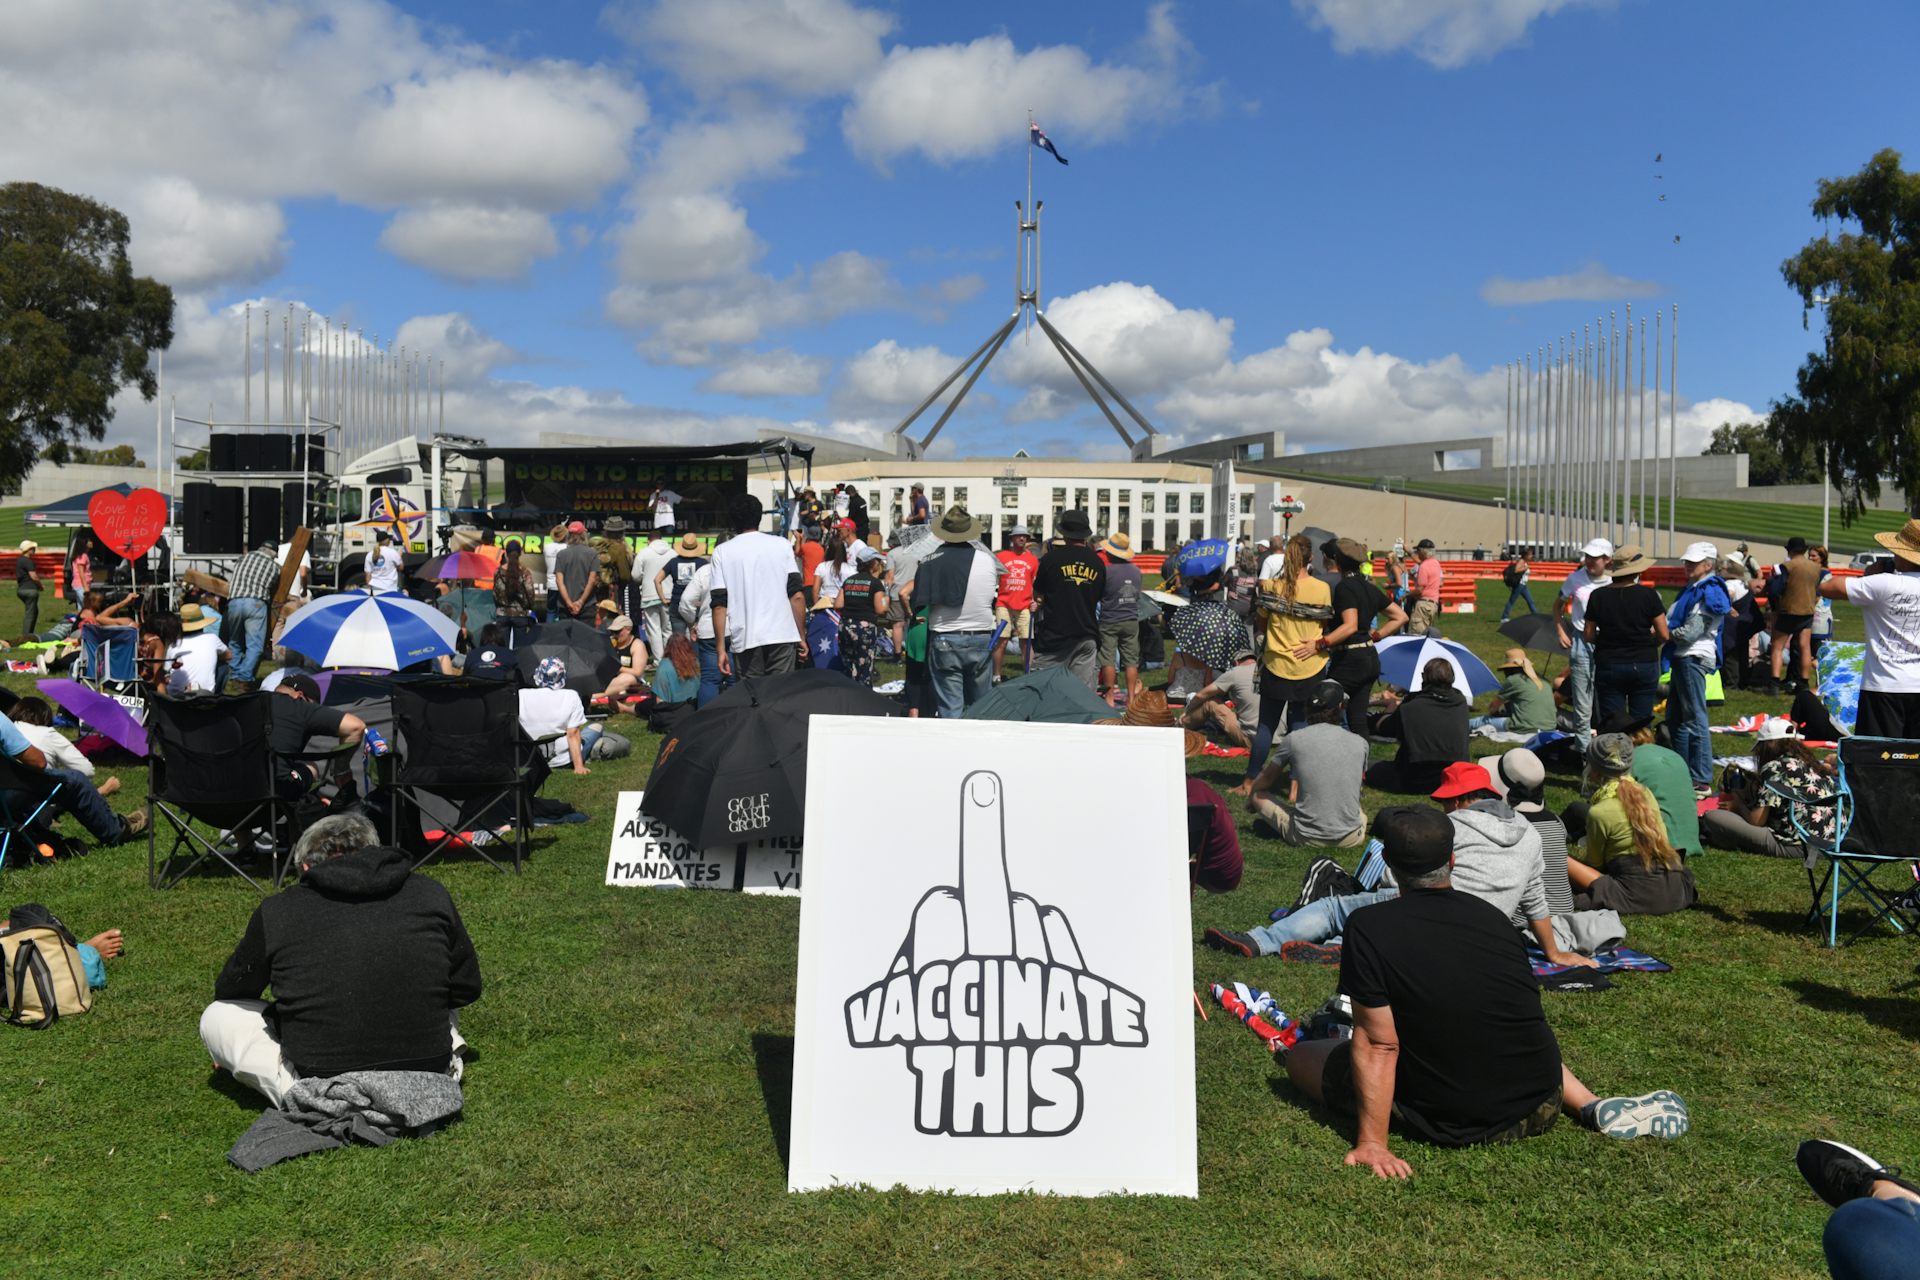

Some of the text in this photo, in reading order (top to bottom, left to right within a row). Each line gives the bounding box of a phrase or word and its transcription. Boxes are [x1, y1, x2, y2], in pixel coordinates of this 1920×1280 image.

[515, 463, 585, 481] BORN
[598, 464, 628, 481] TO
[675, 464, 734, 481] FREE
[575, 500, 652, 511] SOVEREIG
[1060, 564, 1077, 577] THE
[1890, 593, 1920, 604] THEY
[728, 793, 769, 813] GOLF
[729, 805, 769, 823] CART
[729, 816, 770, 832] GROUP
[644, 841, 704, 861] FROM
[613, 862, 720, 881] MANDATES
[844, 957, 1148, 1048] VACCINATE
[905, 1045, 1084, 1137] THIS
